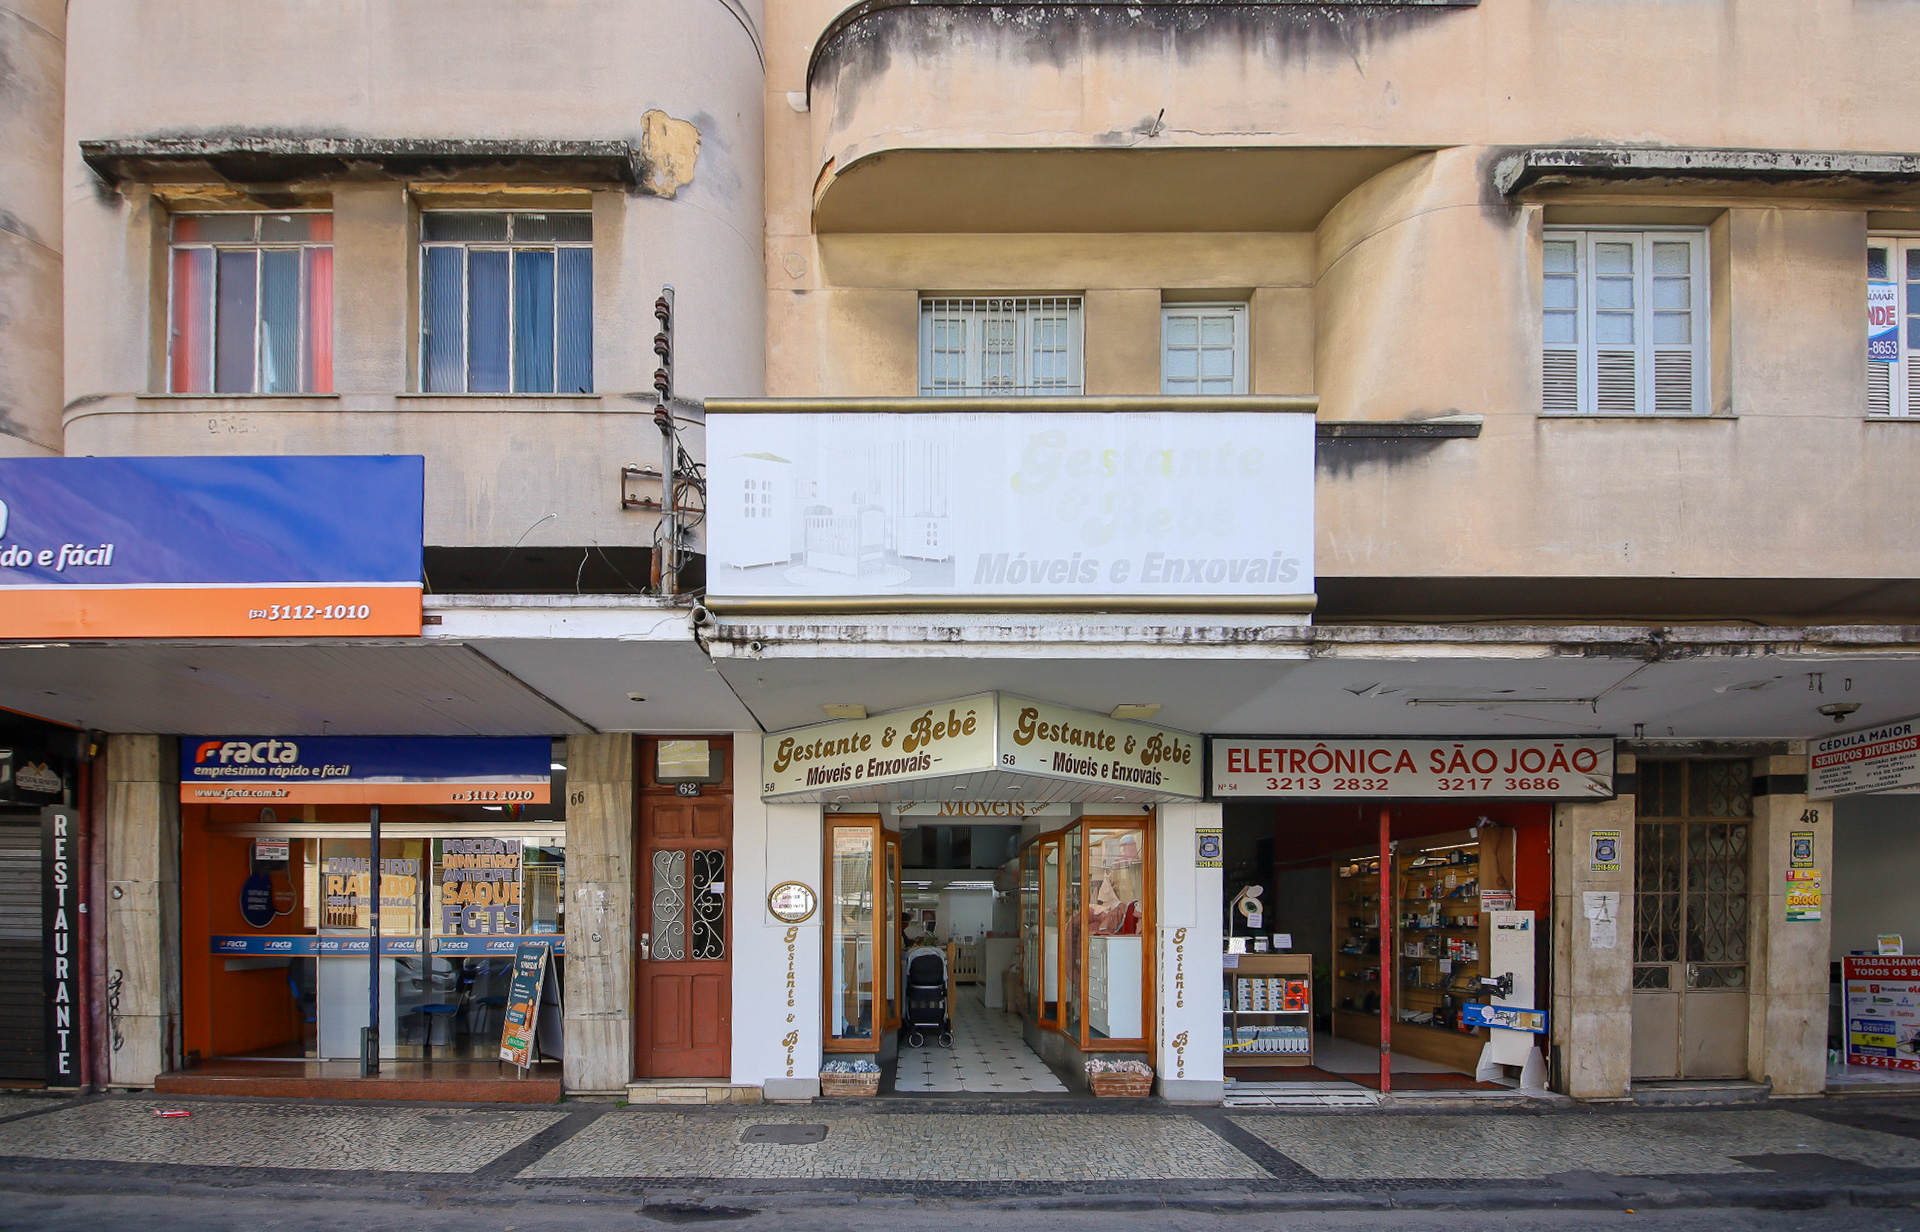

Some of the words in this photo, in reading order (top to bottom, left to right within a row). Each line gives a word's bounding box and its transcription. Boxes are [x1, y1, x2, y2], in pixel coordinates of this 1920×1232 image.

[1011, 429, 1265, 496] Gestante
[37, 550, 54, 566] e
[55, 543, 115, 572] fácil
[973, 552, 1099, 585] Móveis
[1109, 558, 1130, 584] e
[1140, 551, 1300, 585] Enxovais
[249, 608, 268, 620] (32)
[268, 605, 371, 620] 3112-1010
[773, 732, 872, 773] Gestante
[881, 726, 897, 748] &
[902, 708, 977, 753] Bebê
[1012, 707, 1116, 751] Gestante
[1124, 734, 1137, 755] &
[1140, 732, 1192, 765] Bebê
[1819, 734, 1866, 751] CÉDULA
[1869, 724, 1912, 741] MAIOR
[1002, 754, 1016, 765] 58
[1227, 742, 1417, 774] ELETRÔNICA
[1429, 744, 1498, 774] SÃO
[1503, 744, 1598, 774] JOÃO
[1815, 748, 1862, 767] SERVIÇOS
[1864, 737, 1918, 758] DIVERSOS
[193, 765, 267, 778] empréstimo
[268, 764, 309, 778] rápido
[311, 767, 321, 776] e
[321, 764, 351, 778] fácil
[806, 762, 851, 786] Móveis
[854, 763, 864, 779] e
[867, 751, 931, 778] Enxovais
[1052, 751, 1098, 777] Móveis
[1101, 764, 1108, 778] e
[1111, 761, 1162, 786] Enxovais
[194, 788, 289, 800] www.facta.com.br
[465, 790, 534, 801] 3112.1010
[680, 783, 696, 794] 62
[764, 782, 775, 792] 58
[1266, 778, 1321, 791] 3213
[1333, 778, 1389, 791] 2832
[1437, 778, 1491, 791] 3217
[1504, 778, 1561, 791] 3686
[571, 791, 585, 806] 66
[1800, 809, 1819, 823] 46
[443, 839, 505, 854] PRECISA
[443, 868, 512, 881] ANTECIPE
[327, 896, 350, 906] SEM
[442, 881, 525, 908] SAQUE
[442, 905, 520, 935] FGTS
[54, 815, 71, 1075] RESTAURANTE
[784, 926, 798, 1007] Gestante
[1172, 927, 1187, 1008] Gestante
[1854, 968, 1889, 976] TODOS
[1892, 968, 1908, 976] OS
[786, 1013, 795, 1023] &
[782, 1029, 799, 1077] Bebê
[1172, 1031, 1189, 1079] Bebê
